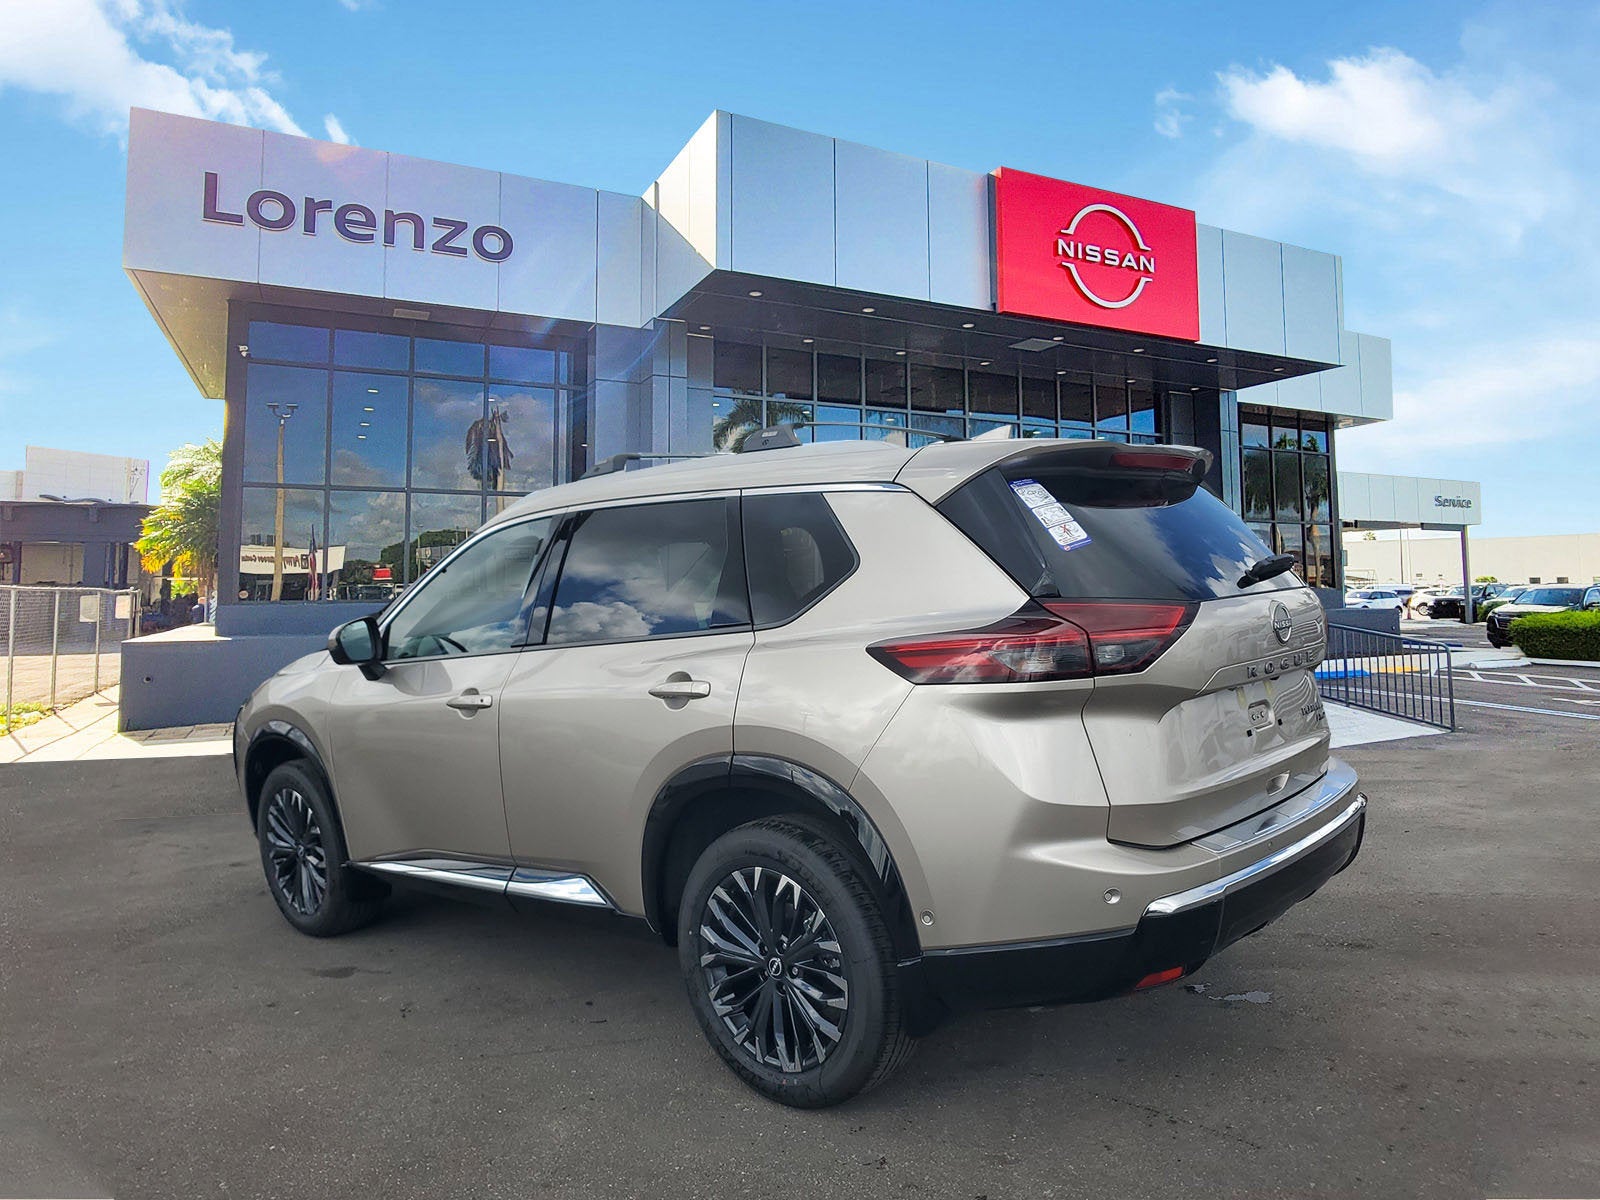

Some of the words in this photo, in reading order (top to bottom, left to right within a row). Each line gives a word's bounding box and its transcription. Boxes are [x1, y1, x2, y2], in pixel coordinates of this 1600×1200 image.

[202, 171, 514, 262] Lorenzo
[1057, 238, 1155, 273] NISSAN
[1434, 495, 1472, 508] Service
[1246, 650, 1315, 679] ROGUE
